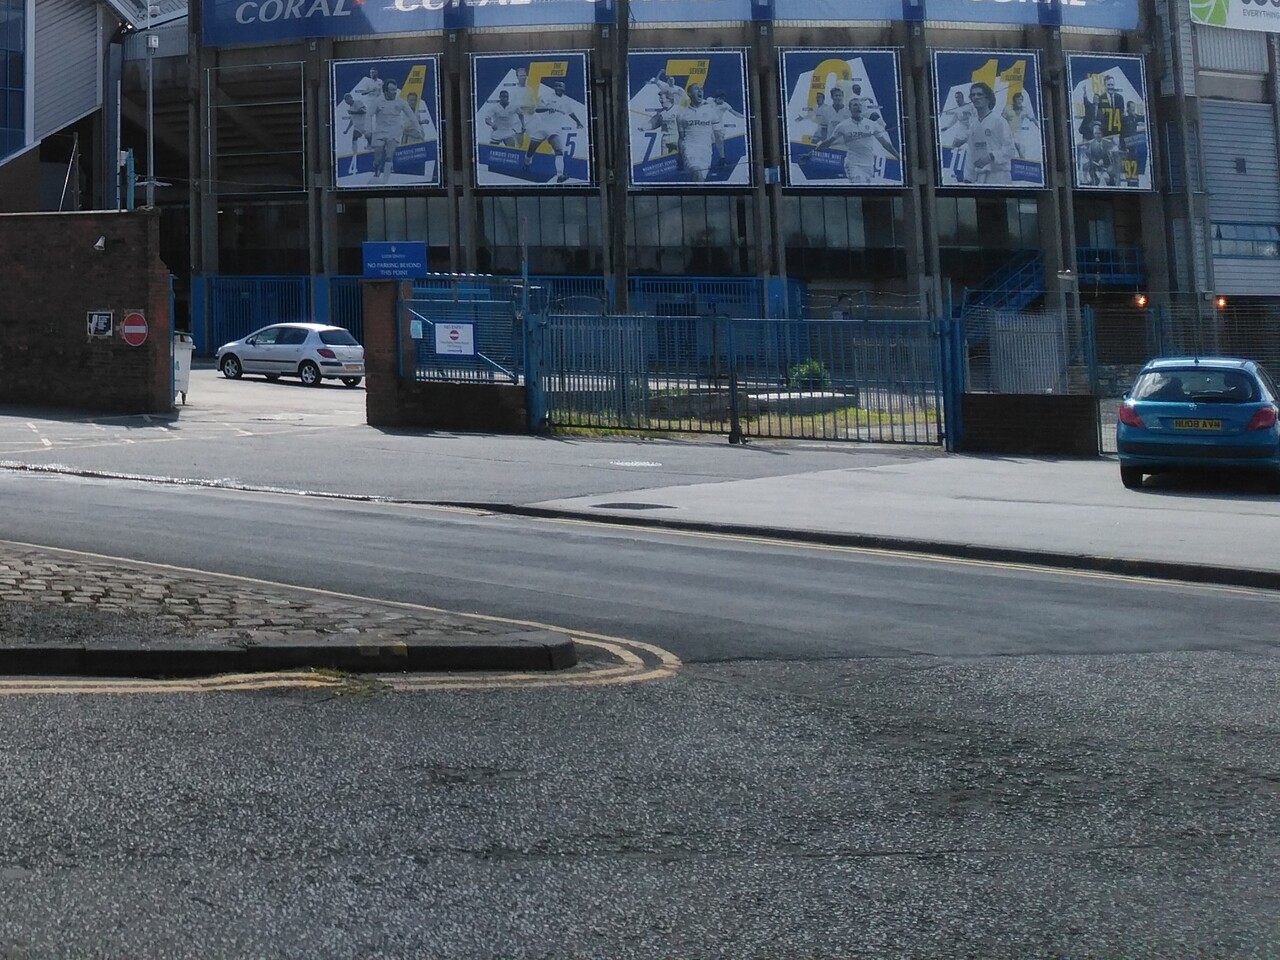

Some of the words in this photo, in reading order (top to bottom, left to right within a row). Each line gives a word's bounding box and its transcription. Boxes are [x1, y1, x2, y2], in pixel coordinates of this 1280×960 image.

[1101, 107, 1122, 132] '74
[642, 132, 658, 164] 7
[1122, 160, 1138, 179] '92
